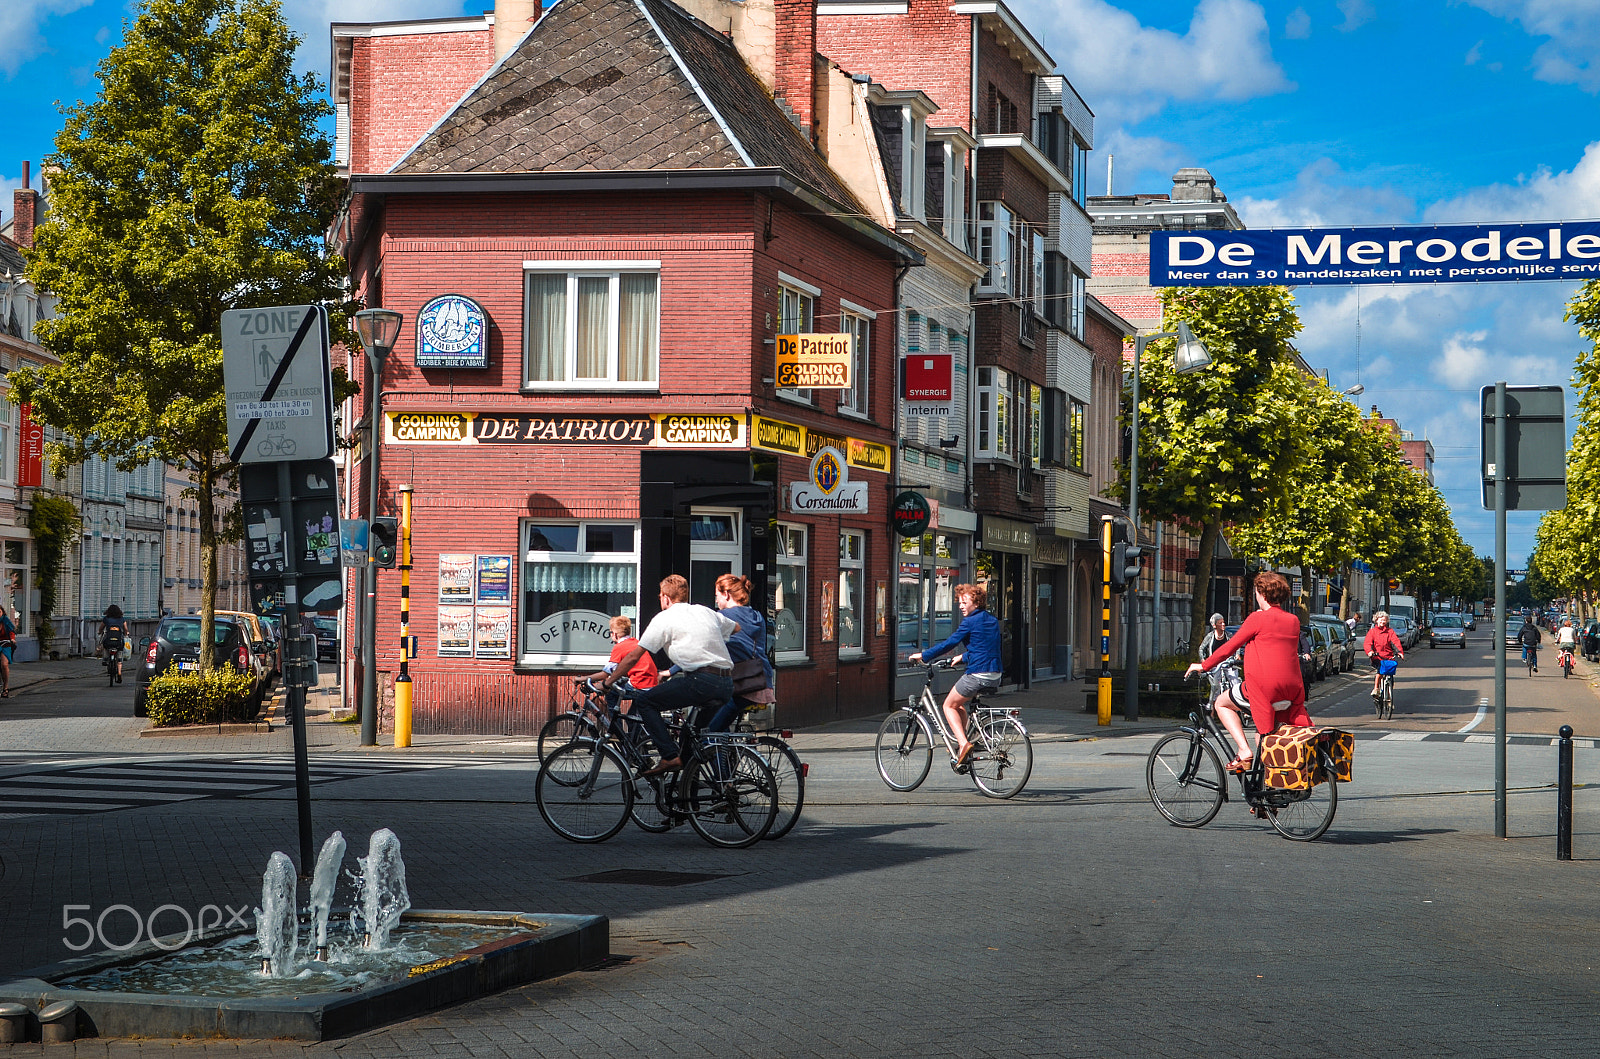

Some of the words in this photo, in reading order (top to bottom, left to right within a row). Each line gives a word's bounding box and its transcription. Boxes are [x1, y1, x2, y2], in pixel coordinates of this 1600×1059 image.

[1168, 236, 1255, 267] De
[1287, 228, 1600, 265] Merodele
[1168, 270, 1210, 280] Meer
[1216, 270, 1249, 279] dan
[1255, 269, 1278, 279] 30
[1284, 268, 1402, 279] handelszaken
[1409, 267, 1443, 277] met
[1449, 264, 1556, 278] persoonlijke
[240, 310, 300, 336] ZONE
[424, 330, 478, 351] GRIMBERGEN
[778, 338, 797, 355] De
[800, 336, 848, 355] Patriot
[781, 364, 844, 375] GOLDING
[779, 374, 845, 385] CAMPINA
[300, 408, 309, 416] 30
[908, 404, 950, 415] interim
[265, 421, 287, 431] TAXIS
[400, 415, 461, 428] GOLDING
[668, 416, 732, 430] GOLDING
[397, 427, 462, 440] CAMPINA
[477, 418, 521, 440] DE
[523, 418, 650, 441] PATRIOT
[666, 429, 733, 443] CAMPINA
[26, 430, 41, 459] Optik
[806, 433, 818, 454] DE
[795, 489, 861, 509] Corsendonk
[895, 511, 925, 520] PALM
[540, 625, 560, 644] DE
[562, 619, 616, 645] PATRIO
